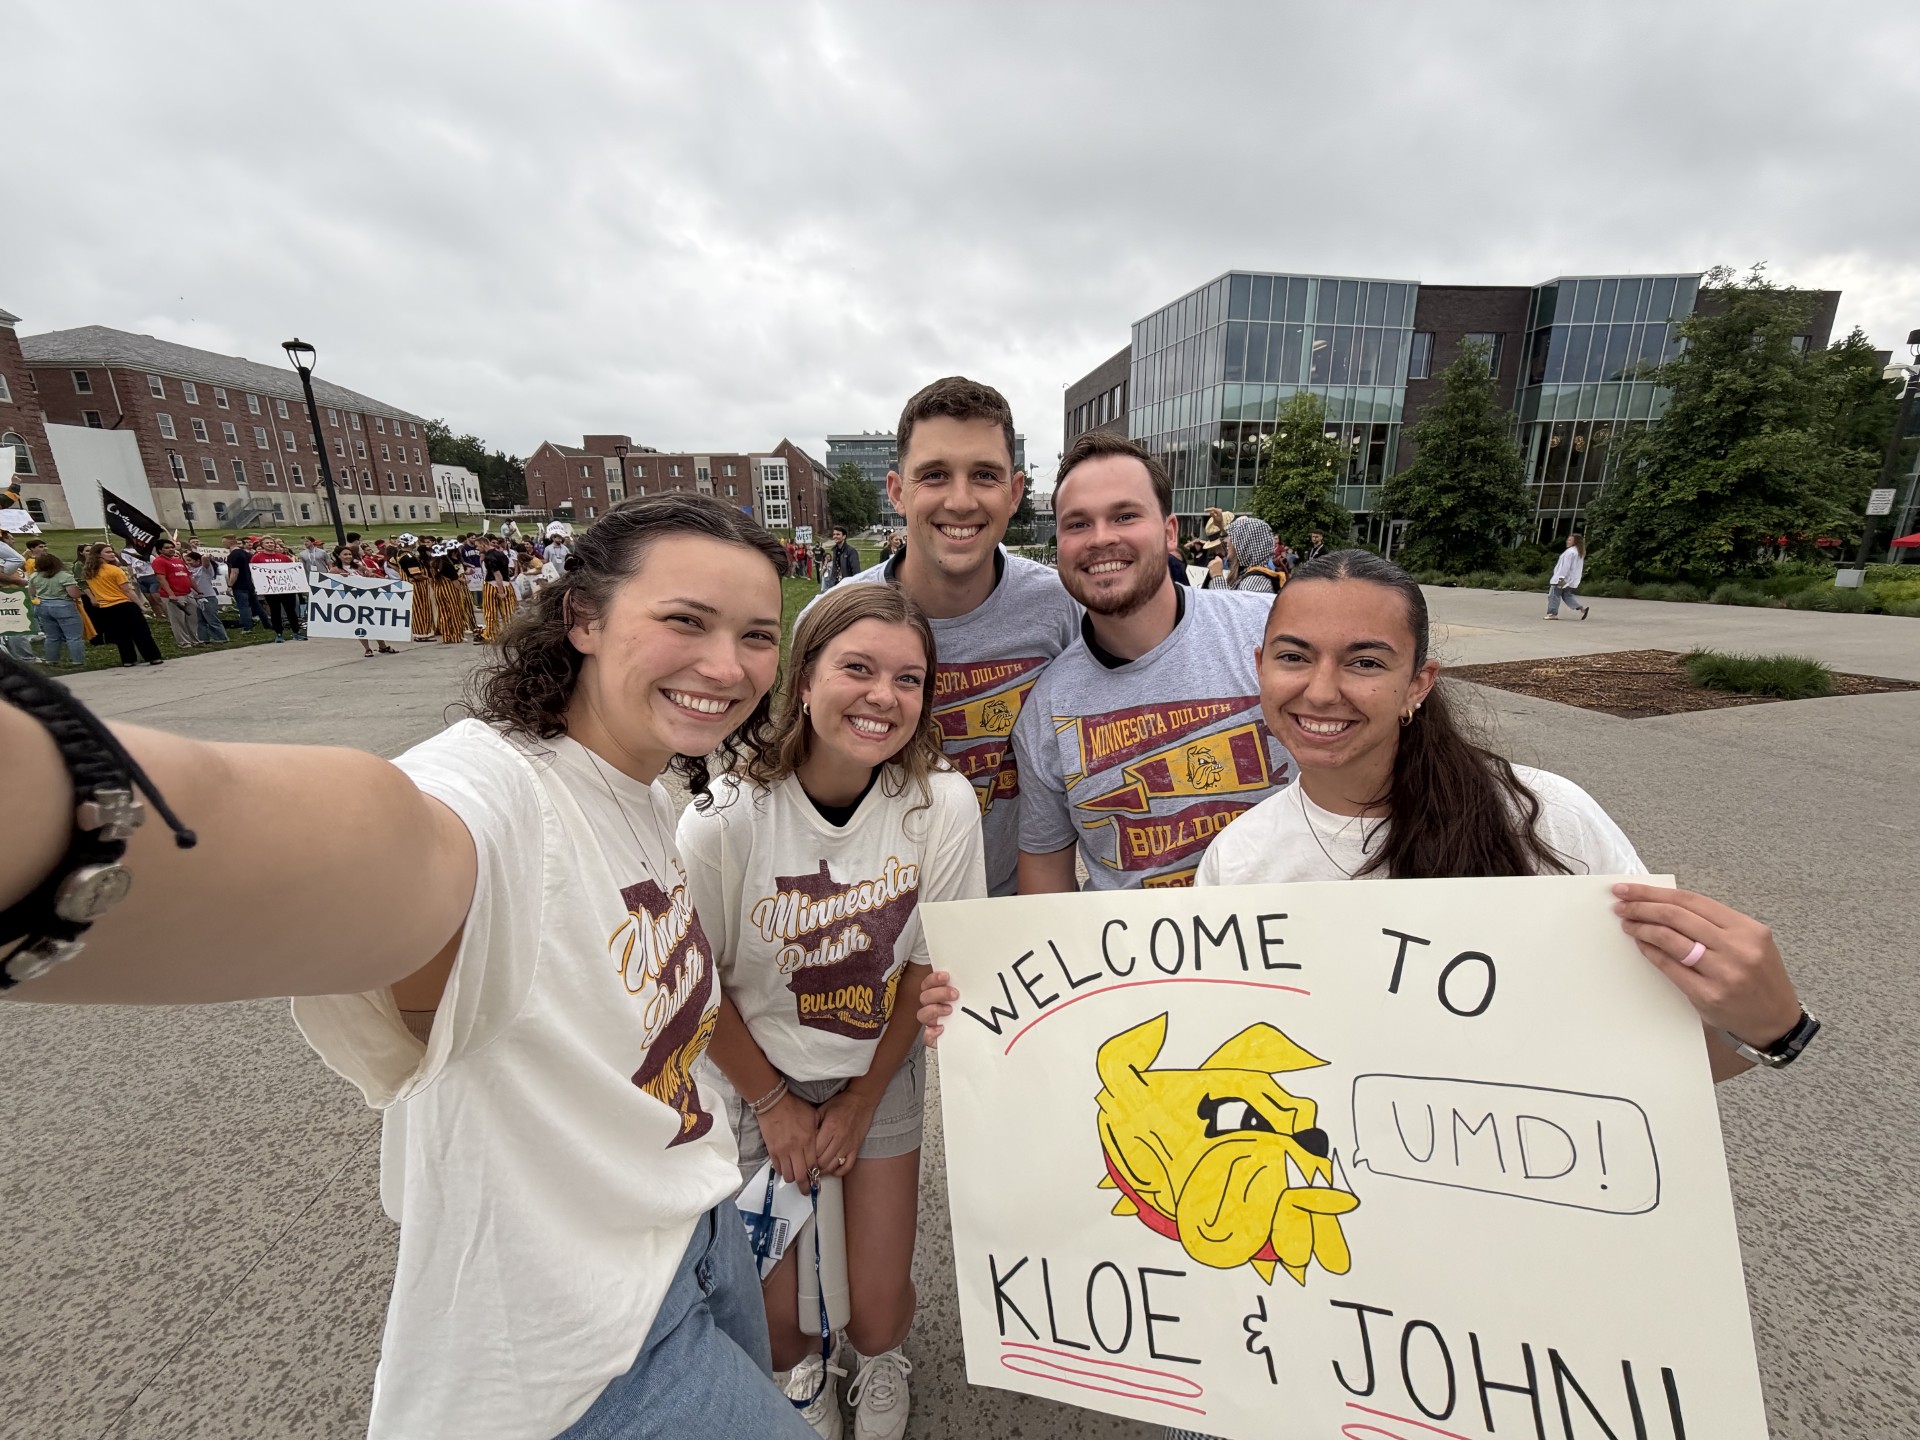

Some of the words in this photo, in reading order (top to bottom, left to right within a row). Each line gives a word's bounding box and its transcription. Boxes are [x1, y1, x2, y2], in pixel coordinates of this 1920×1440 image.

[309, 601, 411, 628] NORTH
[934, 671, 970, 696] SOTA
[971, 663, 1022, 687] DULUTH
[1089, 713, 1168, 760] MINNESOTA
[1169, 703, 1231, 732] DULUTH
[1126, 809, 1246, 857] BULLDO
[751, 856, 919, 943] Minnesota
[776, 924, 871, 975] Duluth
[960, 913, 1303, 1036] WELCOME
[1381, 927, 1497, 1018] TO
[641, 942, 704, 1050] Duluth
[800, 984, 873, 1015] BULLDOGS
[837, 1010, 879, 1029] Minnesota
[1391, 1100, 1609, 1191] UMD!
[988, 1253, 1203, 1365] KLOE
[1242, 1294, 1279, 1386] &
